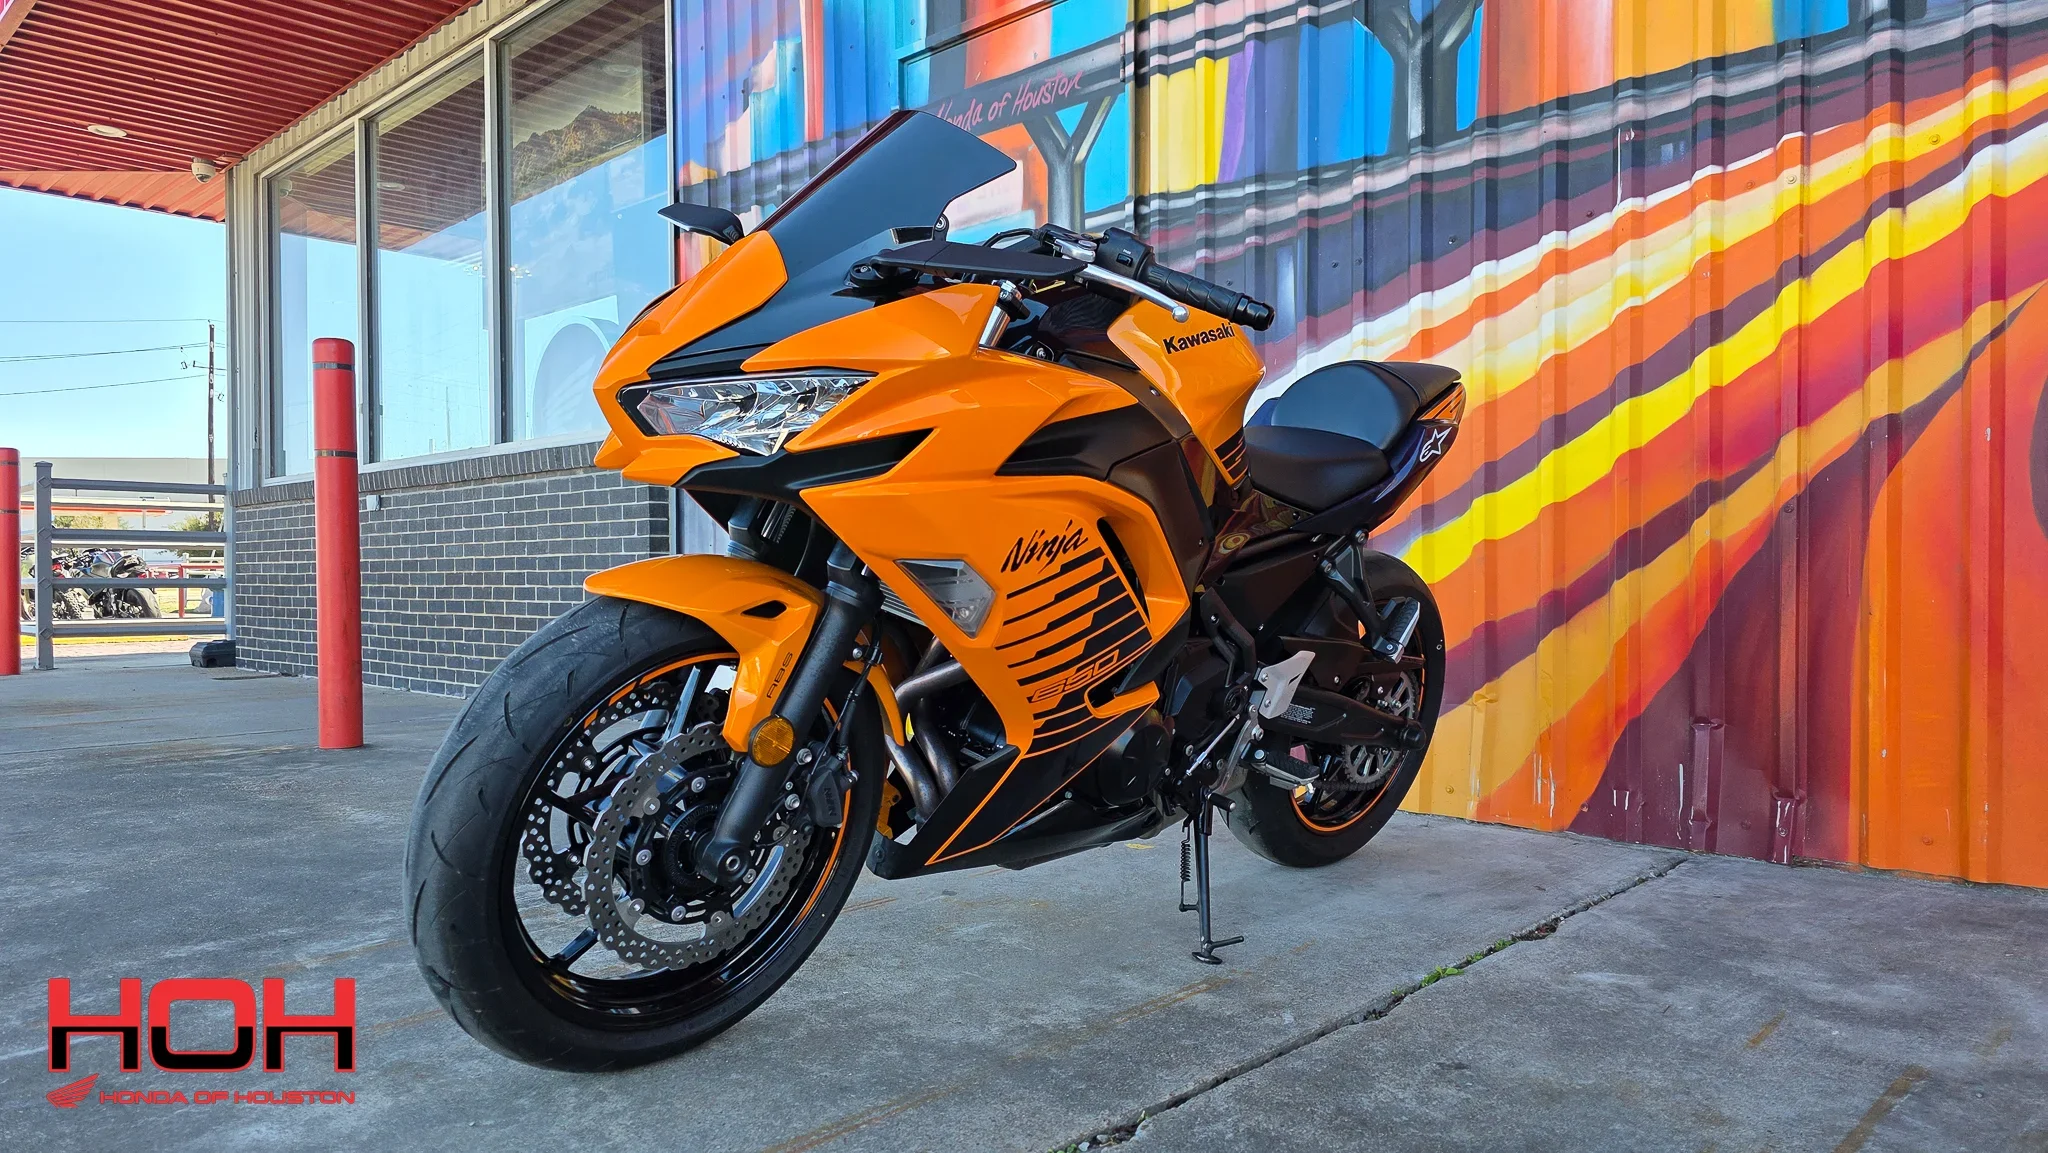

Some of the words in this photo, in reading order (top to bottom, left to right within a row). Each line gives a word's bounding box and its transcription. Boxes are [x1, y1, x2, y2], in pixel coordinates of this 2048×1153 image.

[987, 91, 1012, 121] of
[1011, 69, 1084, 116] Houston
[1162, 322, 1236, 354] Kawasaki
[1001, 519, 1089, 574] Ninja
[766, 651, 794, 699] ABS
[1030, 648, 1120, 703] 650
